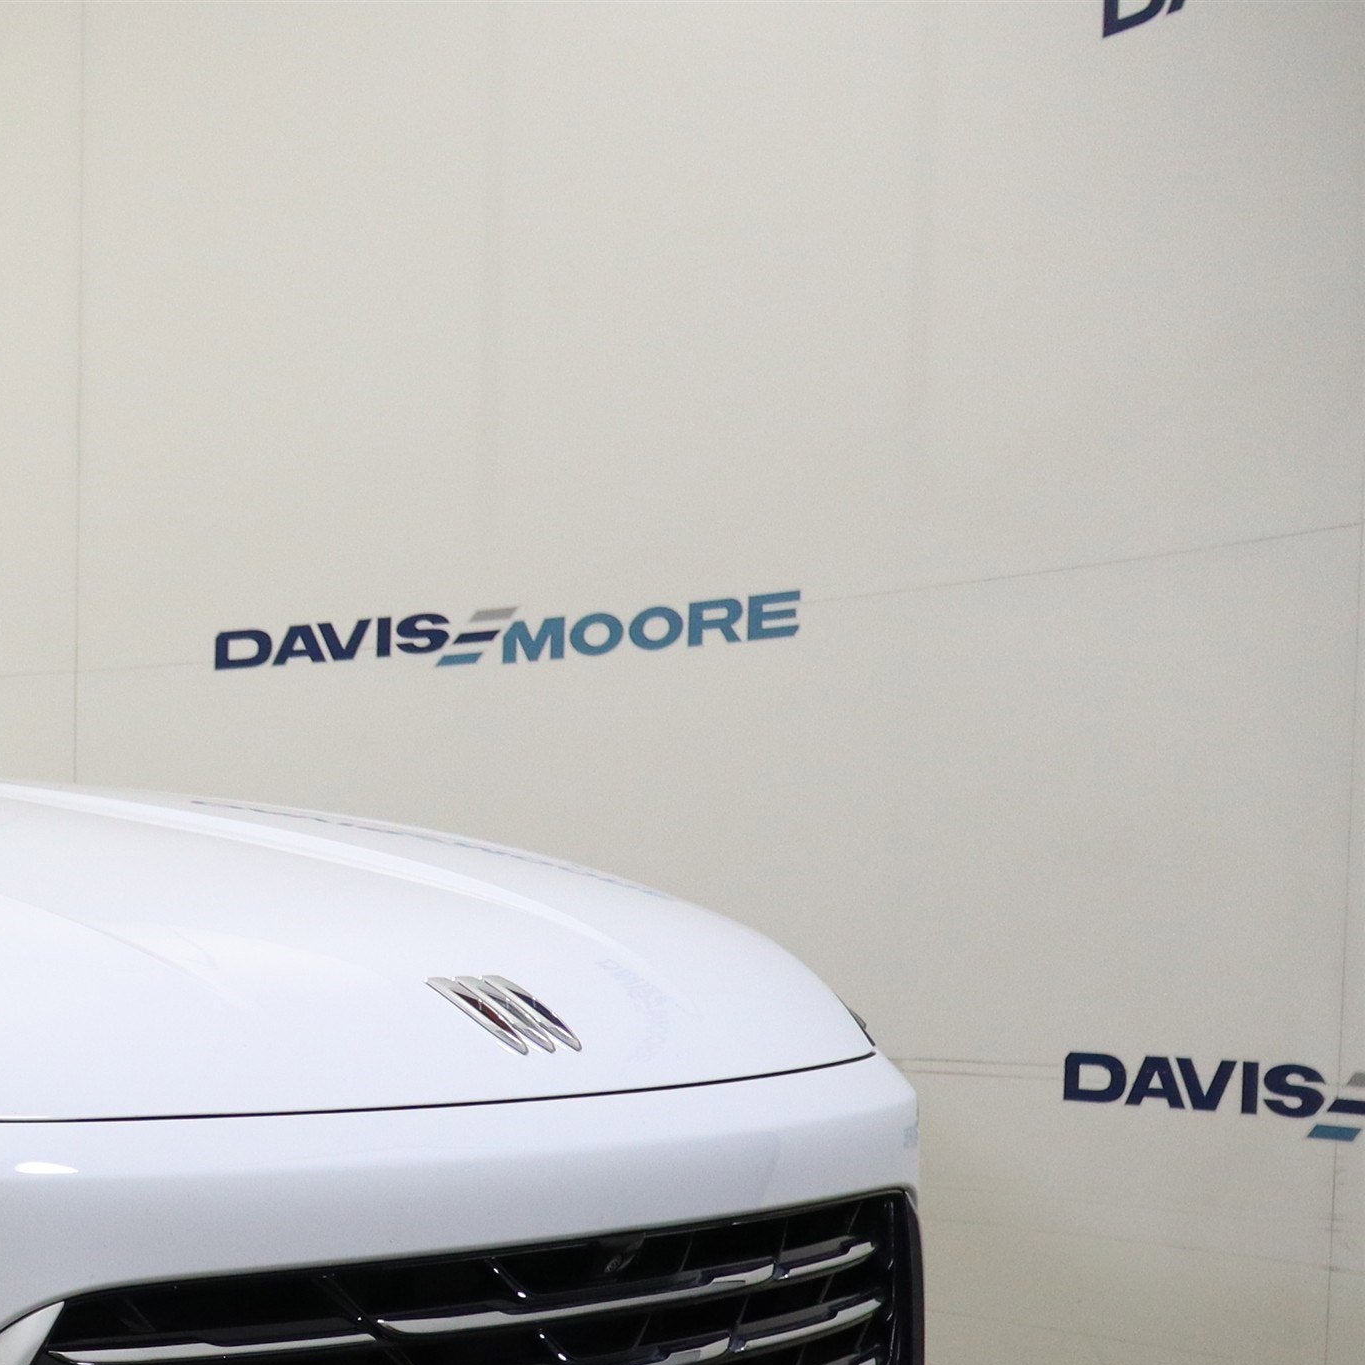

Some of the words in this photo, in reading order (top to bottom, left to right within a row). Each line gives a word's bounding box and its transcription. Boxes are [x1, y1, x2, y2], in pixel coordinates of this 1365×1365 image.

[213, 612, 452, 671] DAVIS
[501, 589, 802, 665] MOORE
[1062, 1051, 1327, 1119] DAVIS
